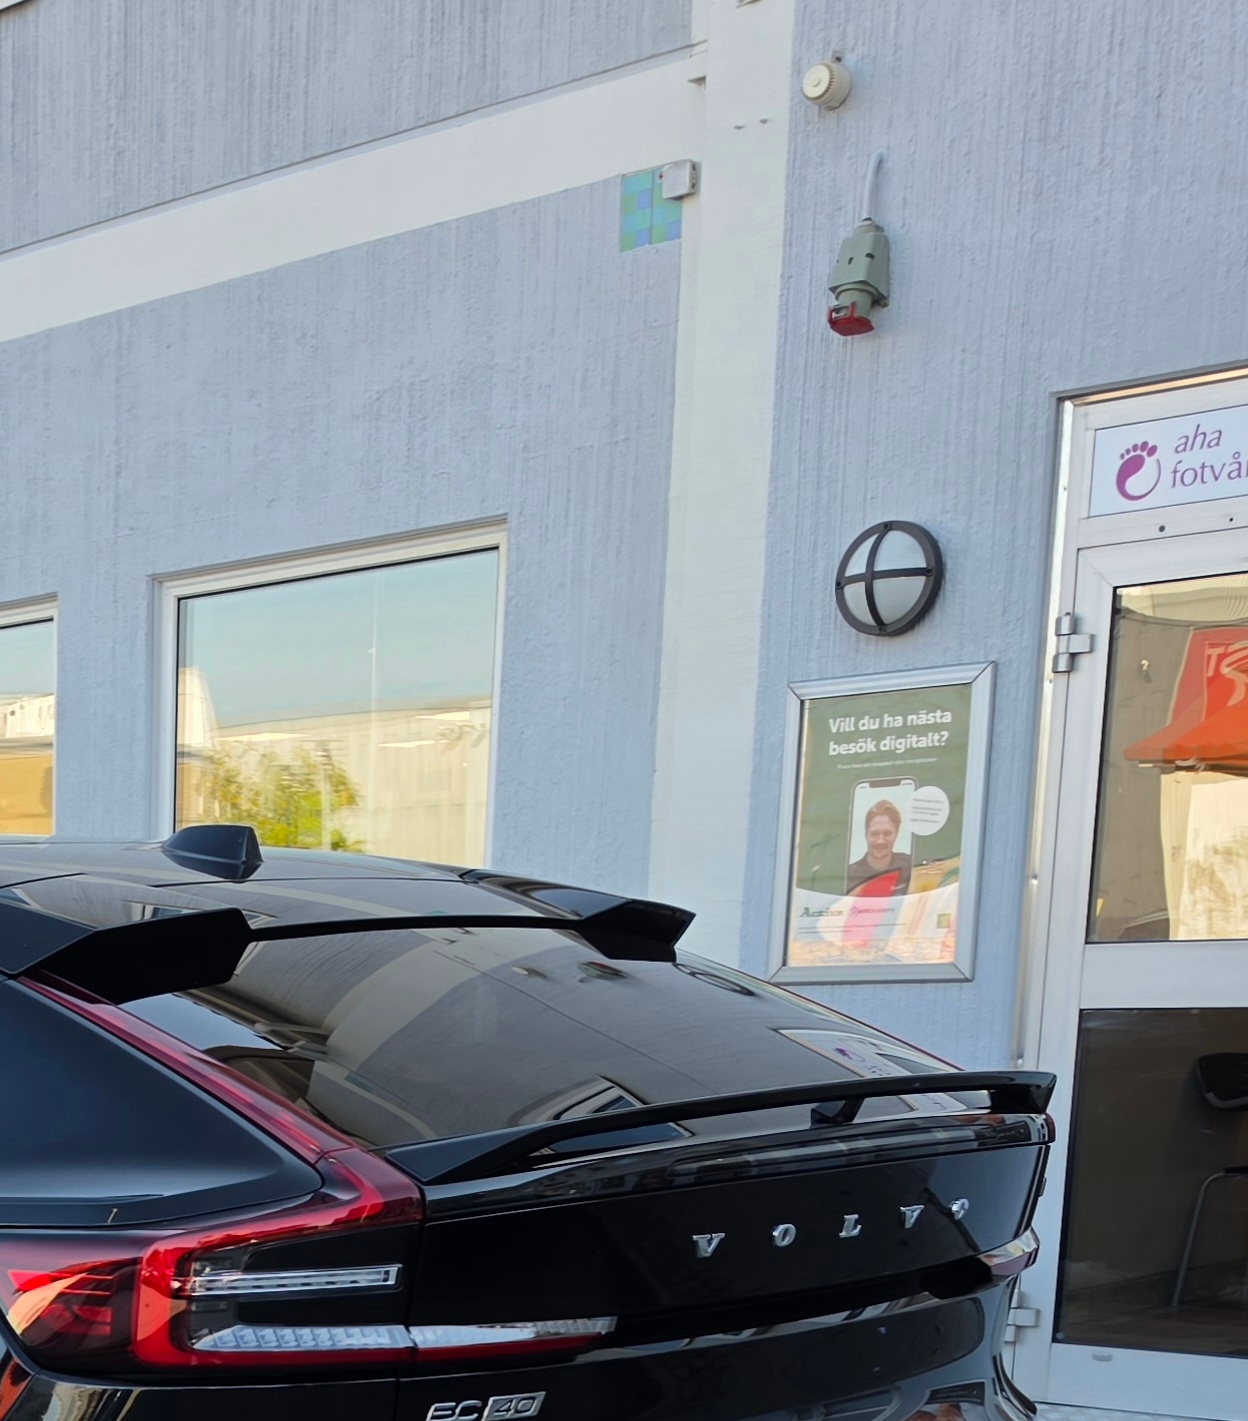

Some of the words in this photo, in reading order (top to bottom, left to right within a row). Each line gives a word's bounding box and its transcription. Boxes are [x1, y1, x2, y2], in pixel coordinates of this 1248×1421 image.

[1174, 423, 1223, 454] aha
[829, 716, 855, 733] Vill
[858, 715, 880, 731] du
[883, 713, 904, 728] ha
[907, 709, 952, 726] nästa
[829, 738, 877, 756] besök
[879, 731, 949, 754] digitalt?
[692, 1198, 969, 1259] VOLVO
